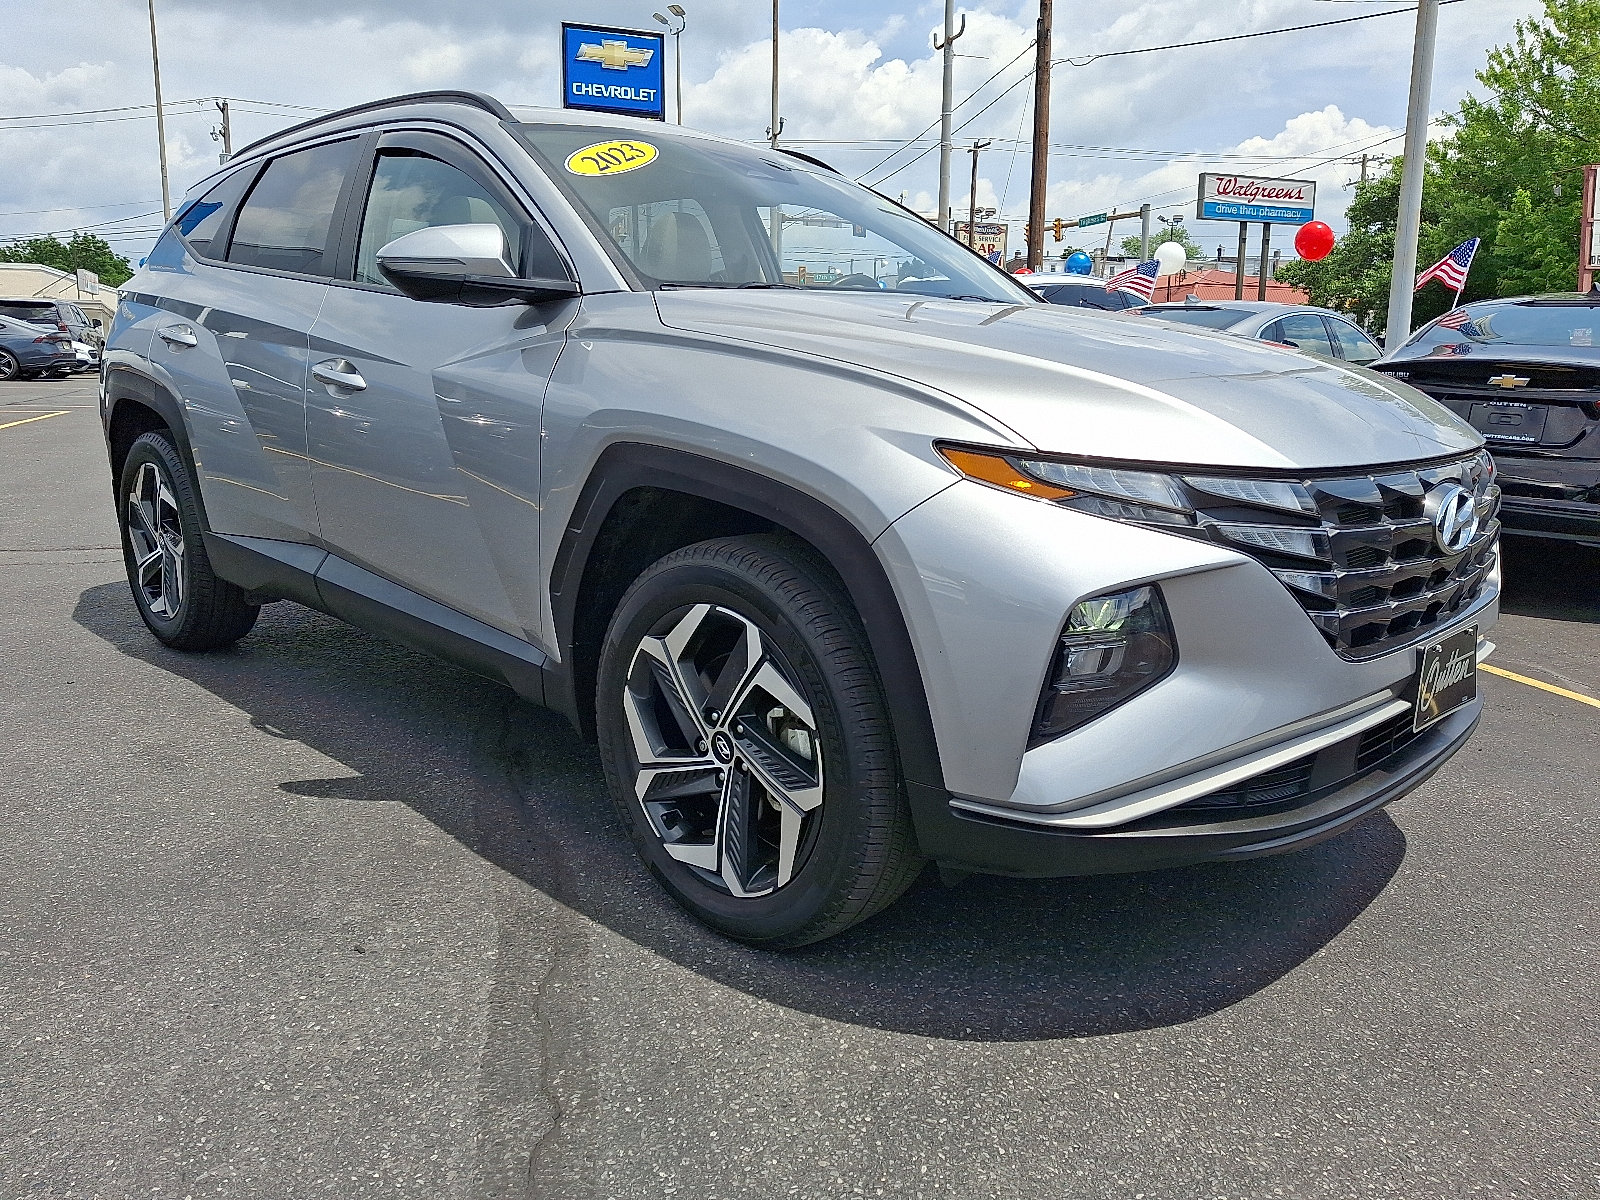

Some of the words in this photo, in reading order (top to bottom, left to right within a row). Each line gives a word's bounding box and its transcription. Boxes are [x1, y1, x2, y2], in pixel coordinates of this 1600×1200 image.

[572, 82, 656, 101] CHEVROLET
[581, 143, 646, 171] 2023
[1216, 176, 1304, 203] Walgreens
[1215, 204, 1238, 215] drive
[1240, 205, 1257, 216] thru
[1259, 207, 1302, 220] pharmacy
[978, 235, 1001, 243] SERVICE
